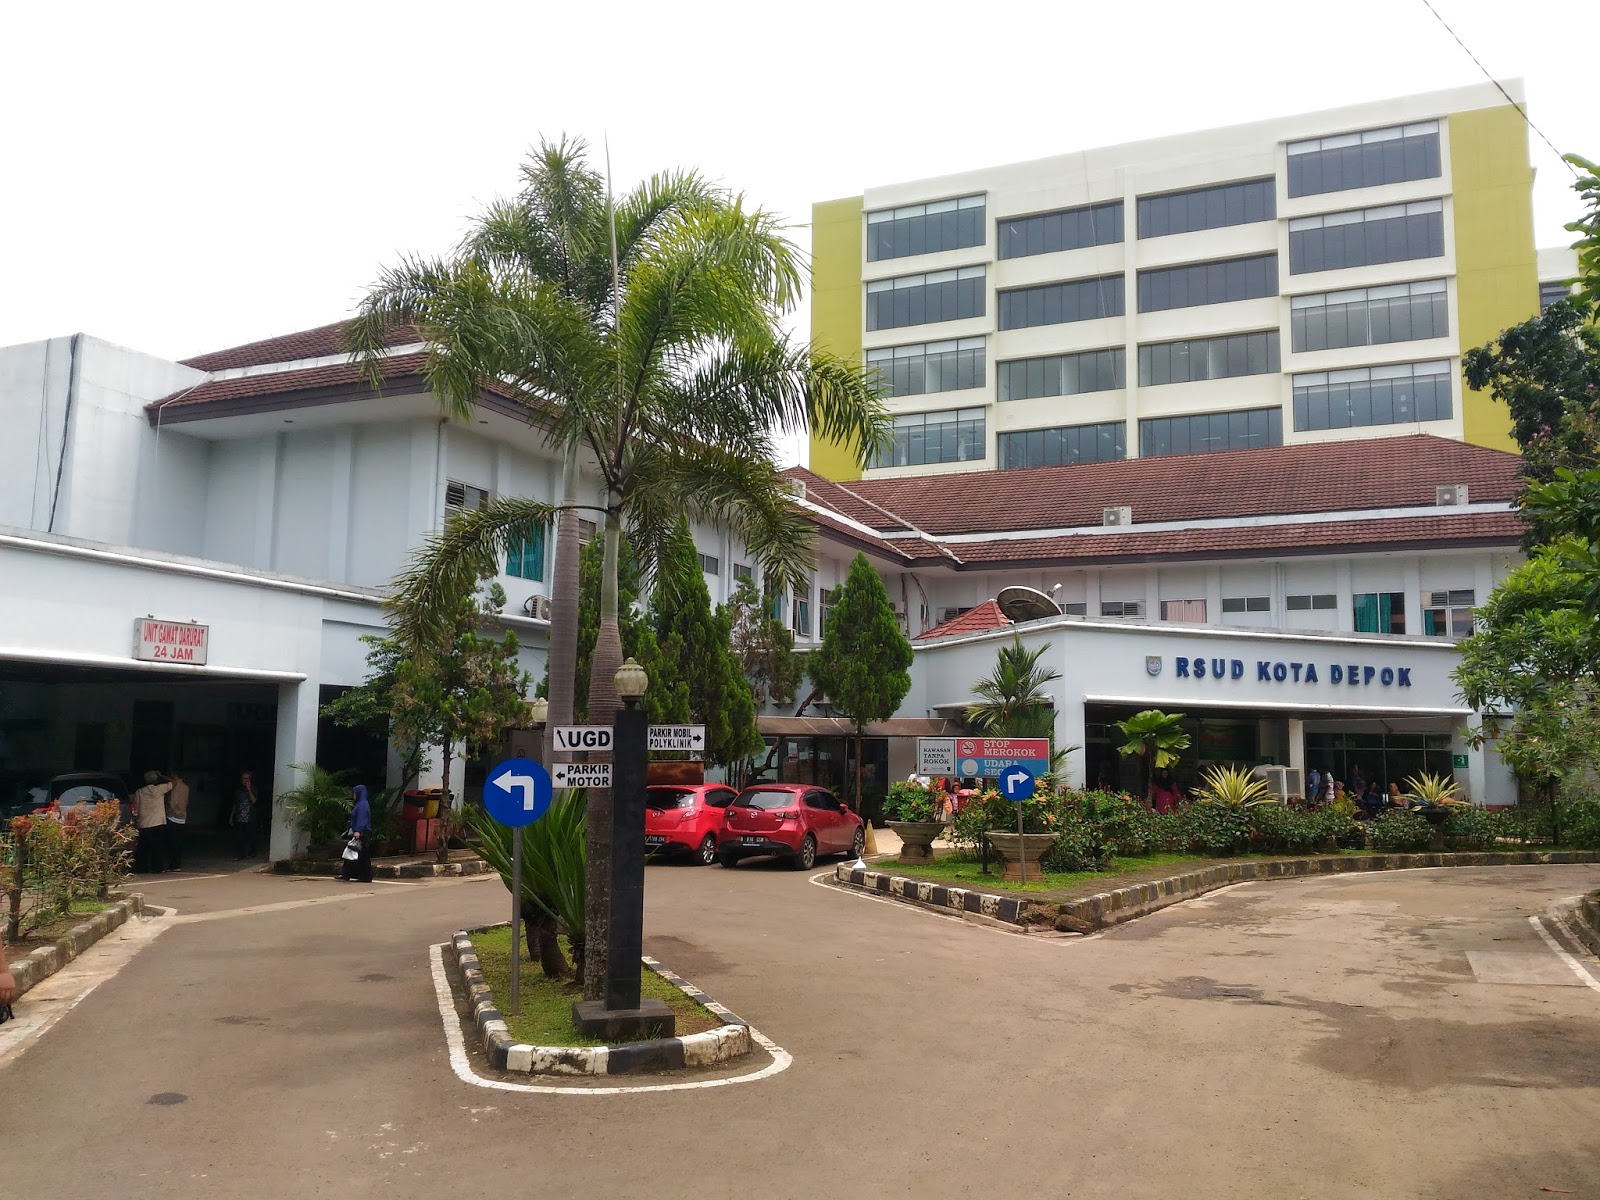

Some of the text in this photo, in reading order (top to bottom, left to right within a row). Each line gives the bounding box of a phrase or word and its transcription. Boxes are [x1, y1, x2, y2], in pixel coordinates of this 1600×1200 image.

[144, 623, 205, 647] UNIT GAWAT DARURAT
[154, 645, 193, 660] 24 JAM
[1175, 656, 1412, 687] RSUD KOTA DEPOK
[649, 728, 692, 738] PARKIR MOBIL
[567, 730, 611, 748] UGD
[649, 738, 692, 748] POLYKLINIK
[983, 740, 1010, 748] STOP
[983, 748, 1036, 757] MEROKOK
[984, 759, 1018, 768] UDARA
[567, 764, 610, 775] PARKIR
[567, 776, 610, 787] MOTOR
